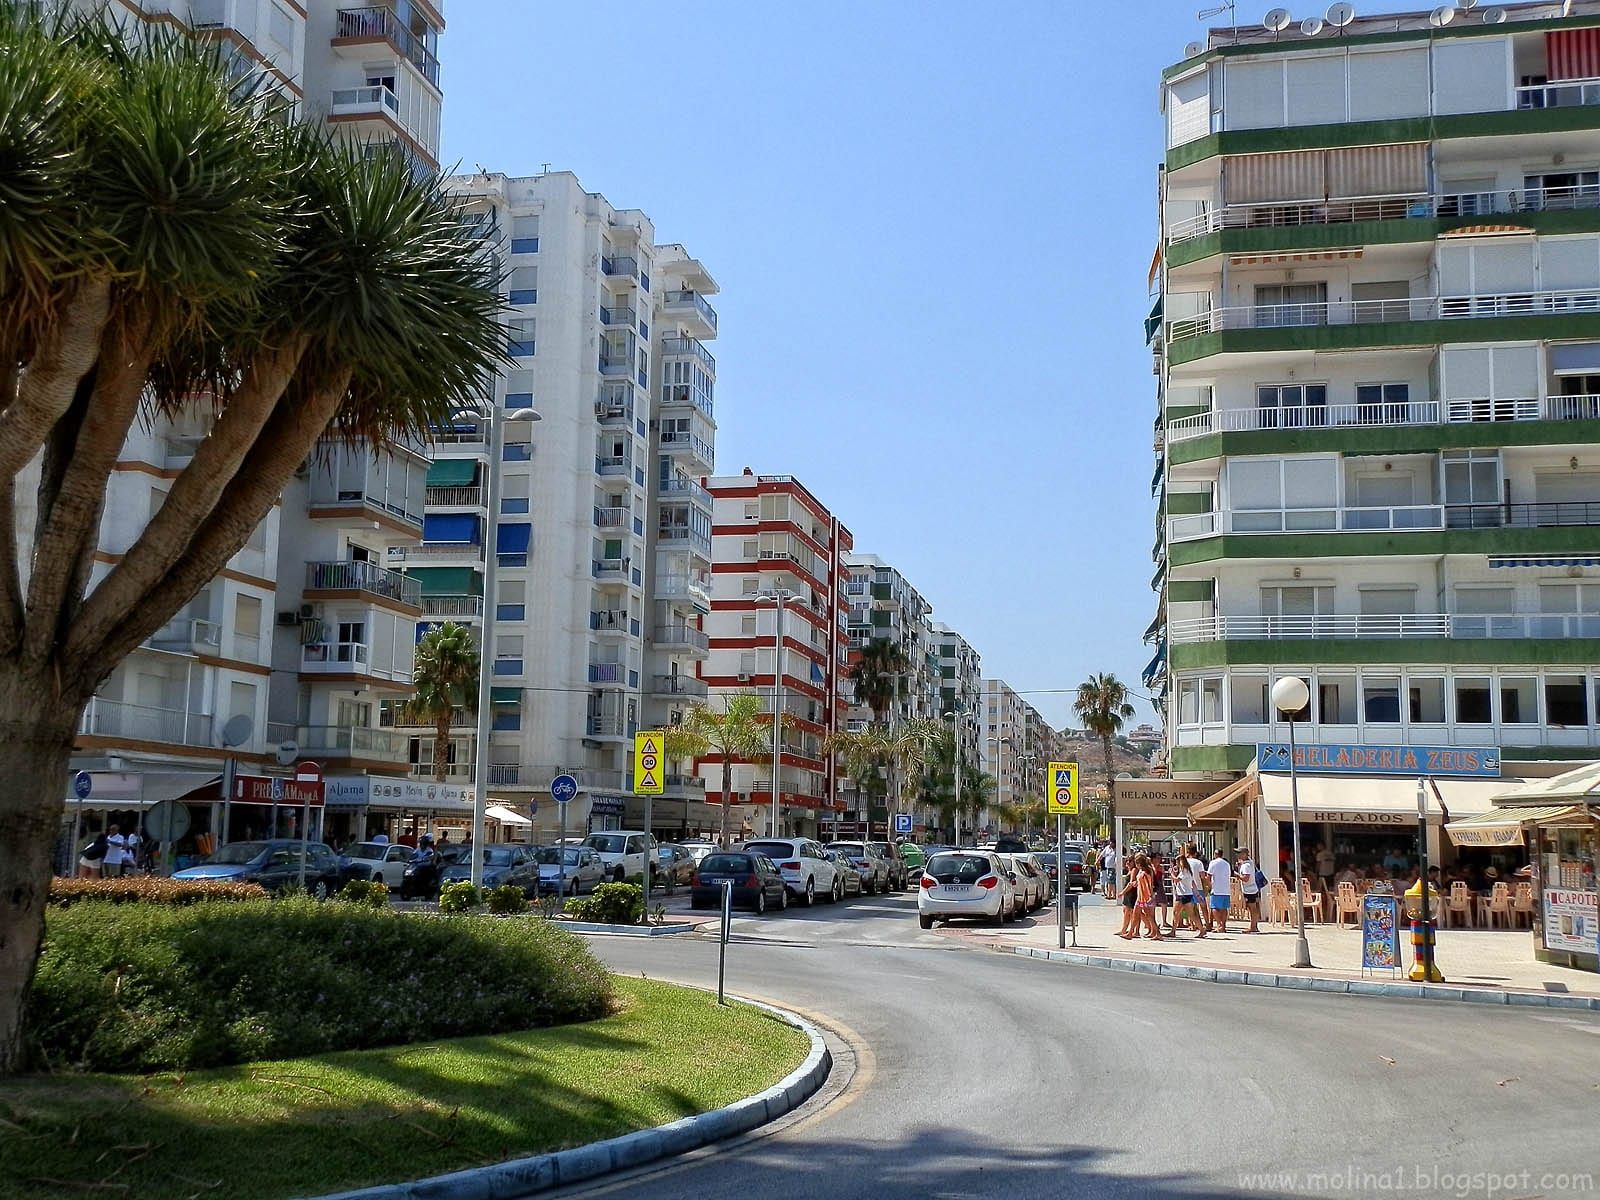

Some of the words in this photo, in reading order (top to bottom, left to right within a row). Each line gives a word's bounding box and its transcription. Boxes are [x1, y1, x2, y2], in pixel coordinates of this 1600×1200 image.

[1293, 746, 1419, 770] HELADERIA
[1427, 750, 1481, 771] ZEUS
[1121, 791, 1168, 800] HELADOS
[1171, 791, 1215, 800] ARTESA
[899, 816, 910, 830] P
[1314, 812, 1404, 824] HELADOS
